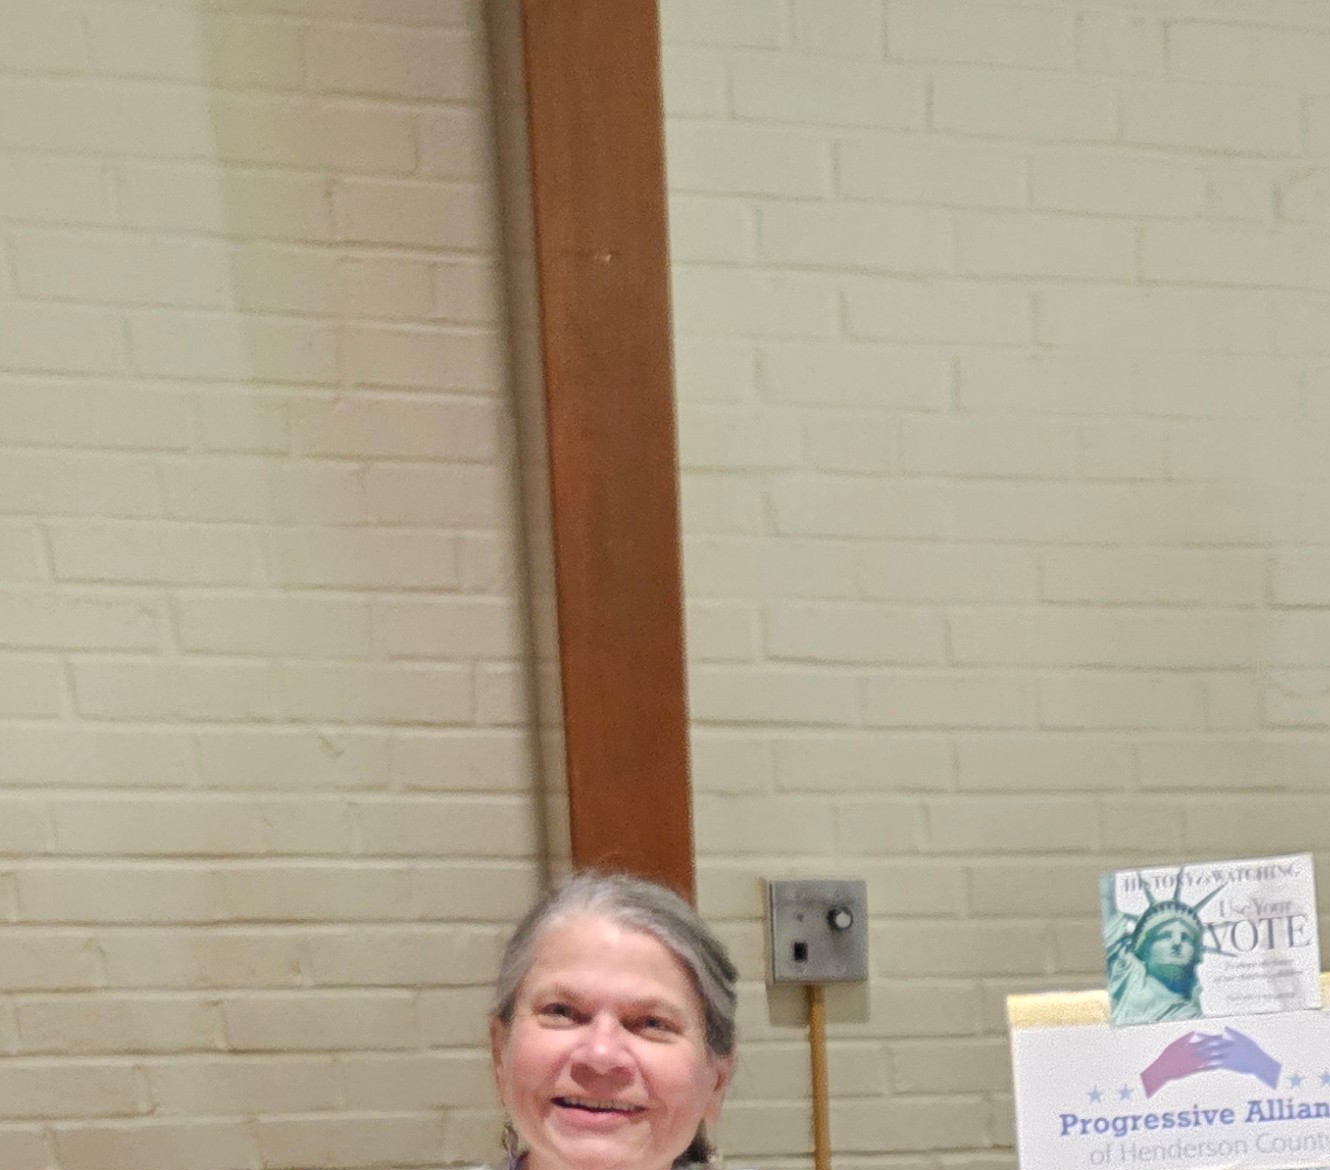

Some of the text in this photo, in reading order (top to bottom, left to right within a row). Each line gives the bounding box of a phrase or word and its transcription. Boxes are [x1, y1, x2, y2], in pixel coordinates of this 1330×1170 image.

[1203, 915, 1312, 953] VOTE
[1059, 1104, 1235, 1137] Progressive
[1090, 1144, 1112, 1165] of
[1121, 1137, 1248, 1163] Henderson
